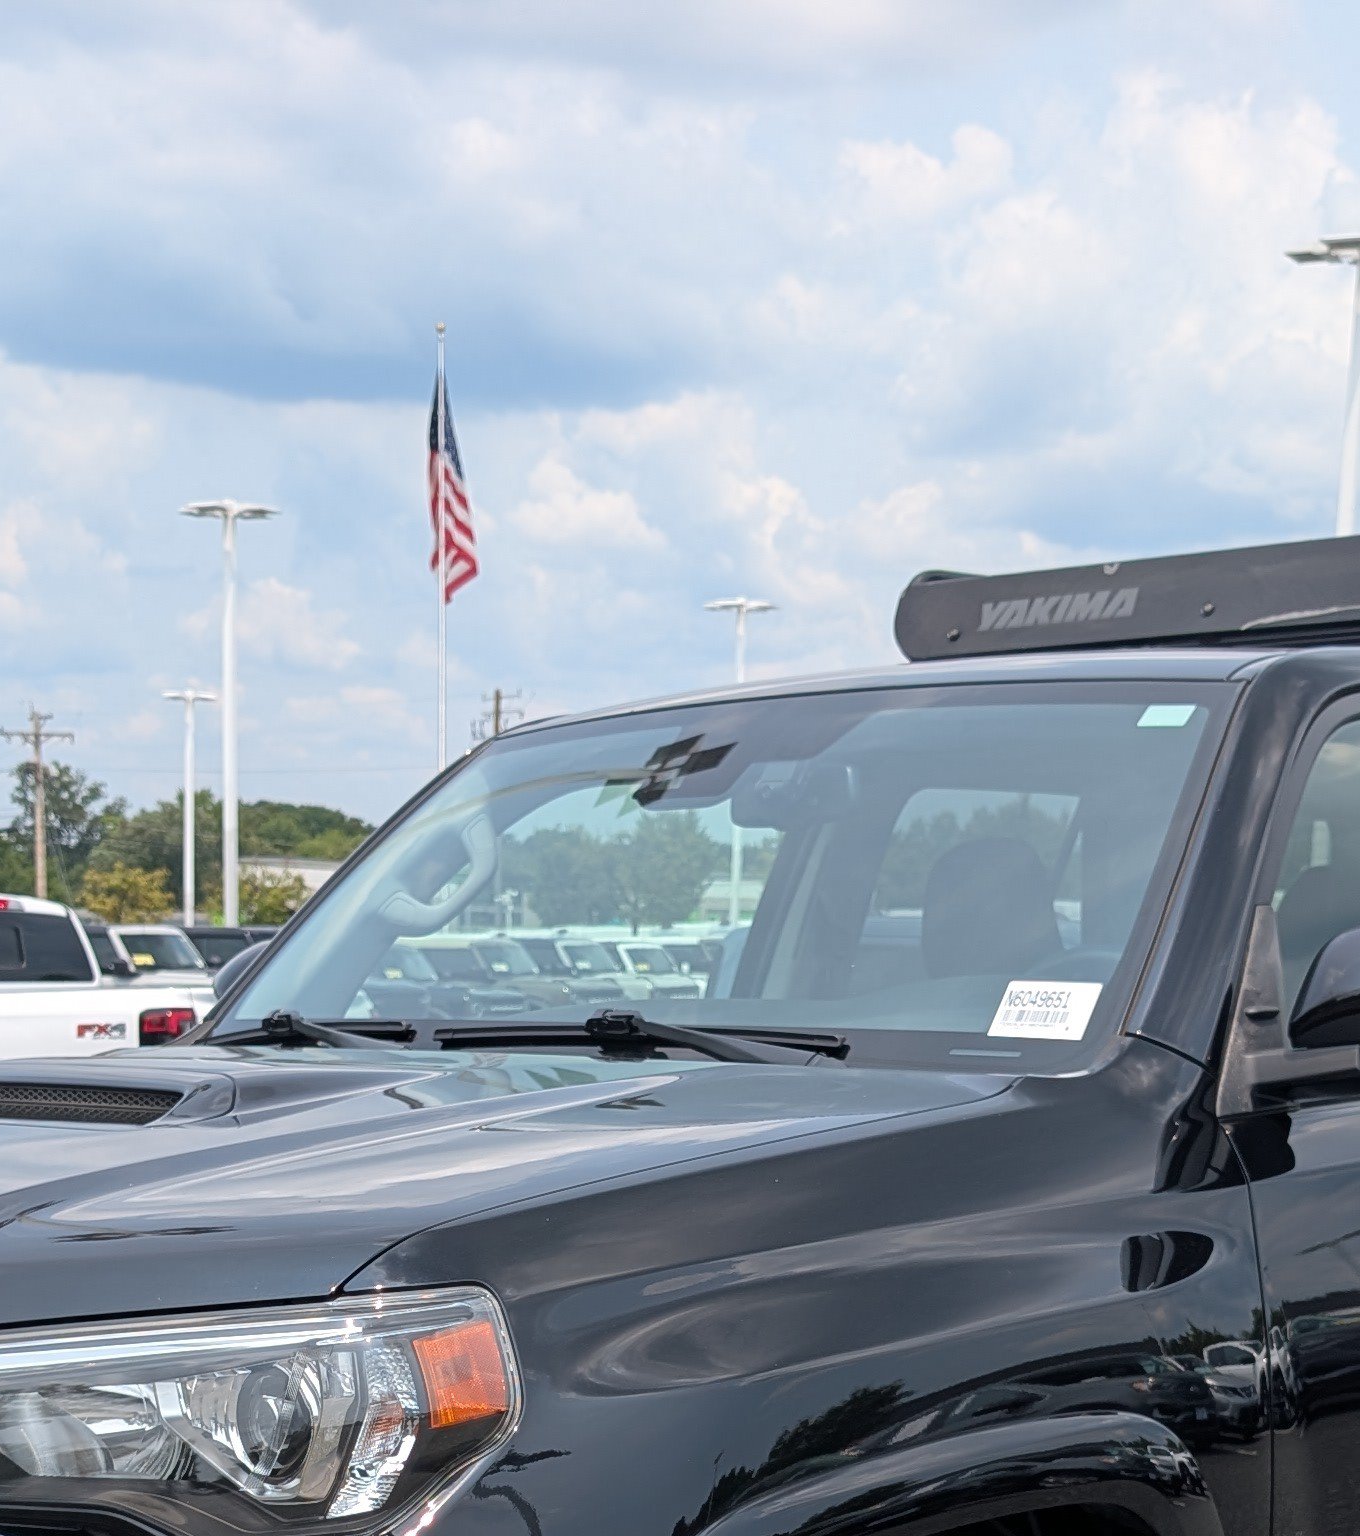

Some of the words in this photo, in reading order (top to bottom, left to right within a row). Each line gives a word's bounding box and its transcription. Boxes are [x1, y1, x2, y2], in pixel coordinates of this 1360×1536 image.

[977, 586, 1140, 632] YAKIMA
[1005, 989, 1072, 1010] N6049651
[77, 1023, 127, 1039] FX4
